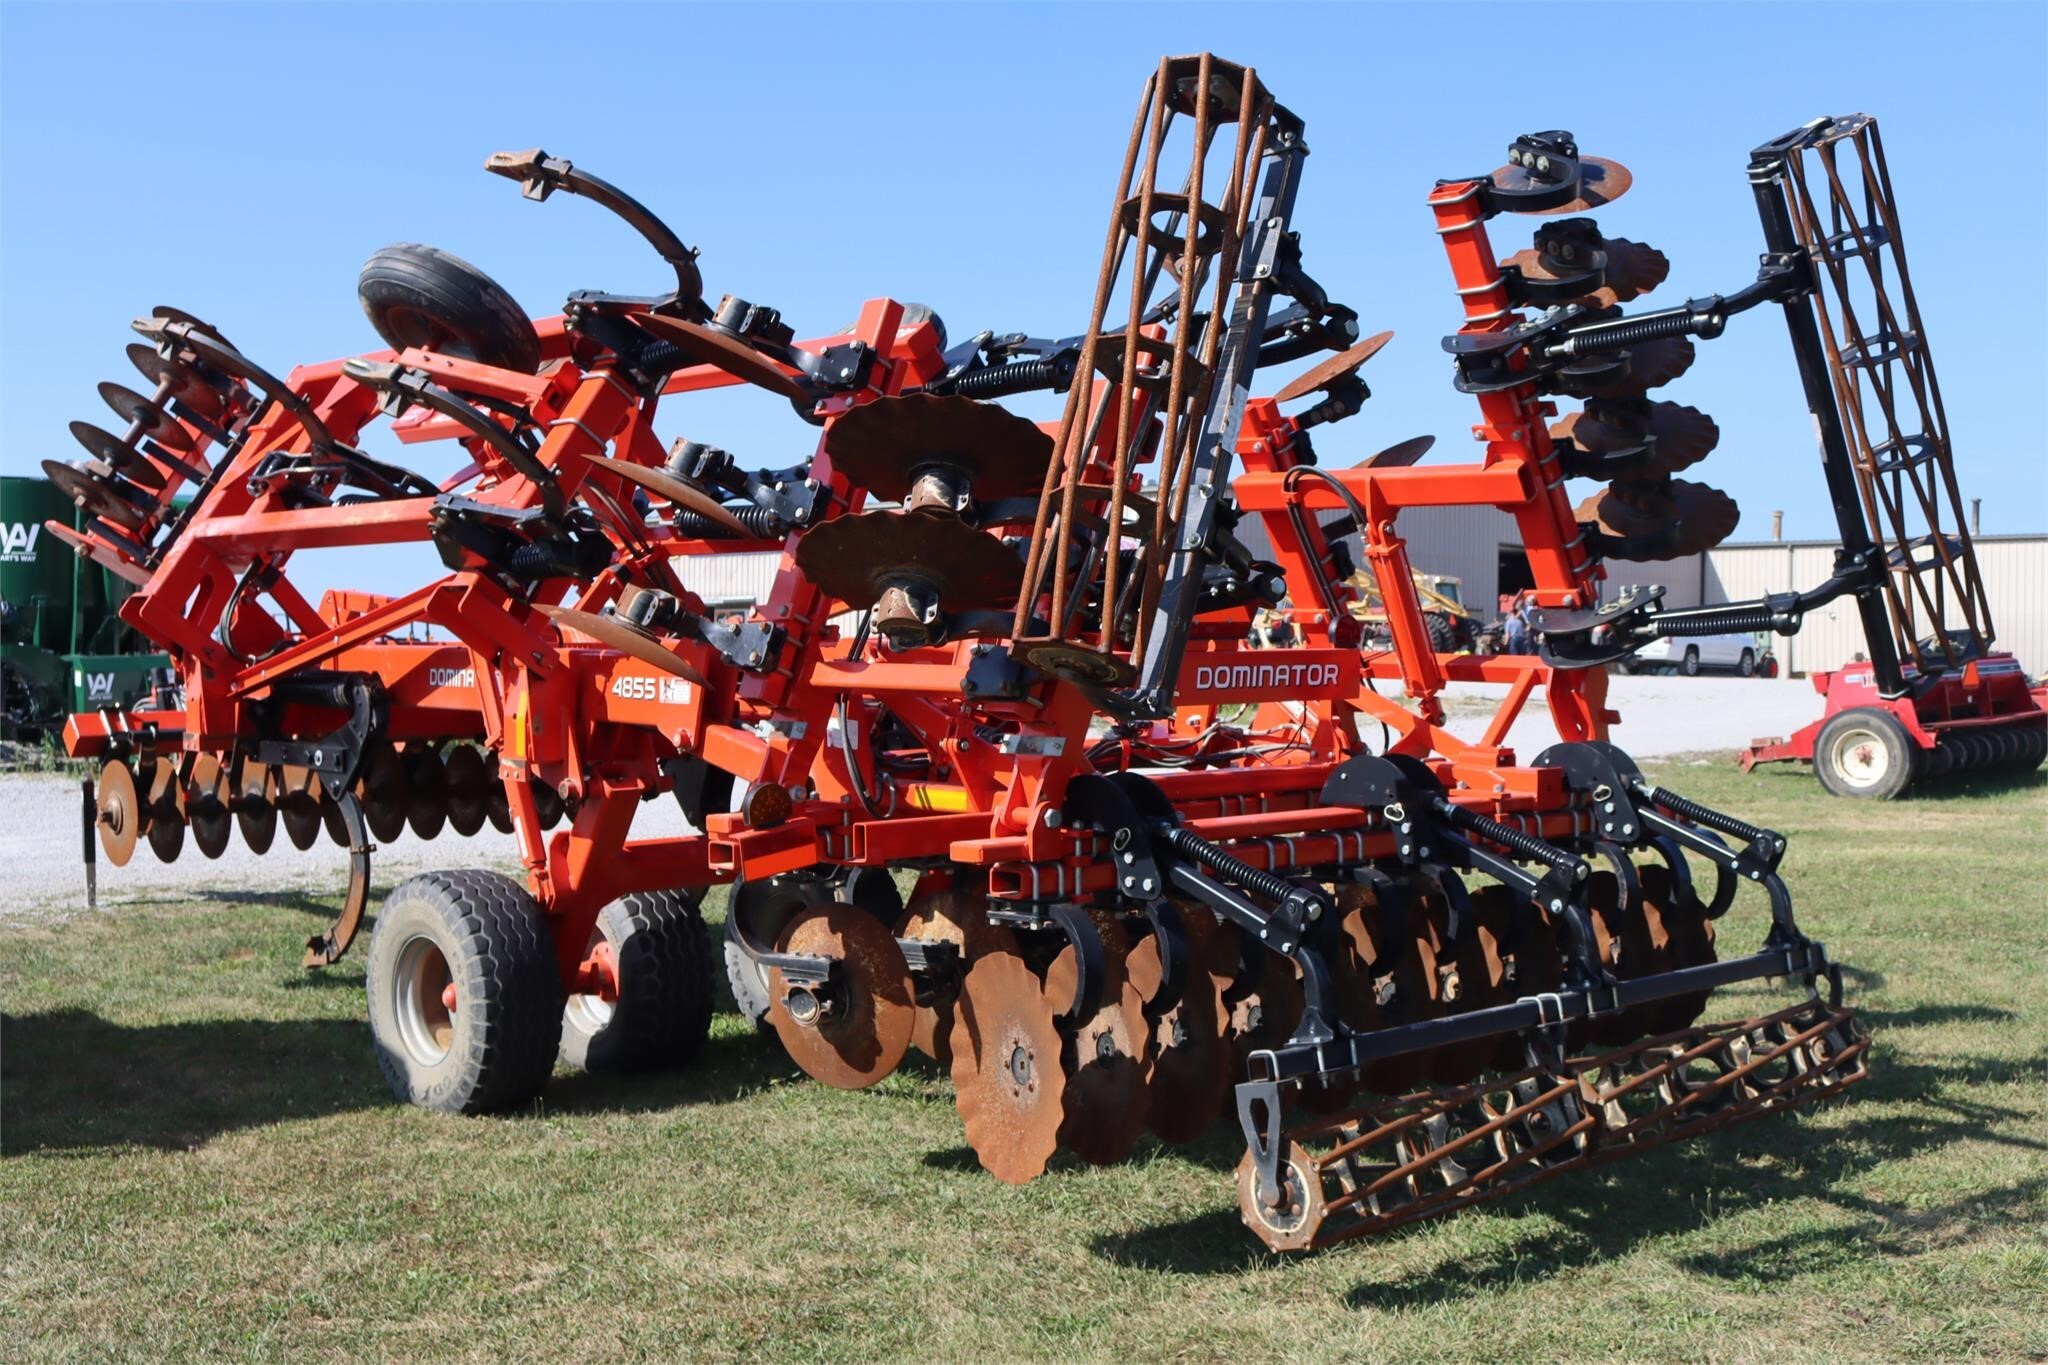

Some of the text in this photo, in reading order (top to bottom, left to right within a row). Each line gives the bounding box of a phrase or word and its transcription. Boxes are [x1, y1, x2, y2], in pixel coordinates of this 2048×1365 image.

[429, 667, 475, 688] DOMINA
[611, 676, 656, 700] 4855
[1196, 664, 1339, 689] DOMINATOR
